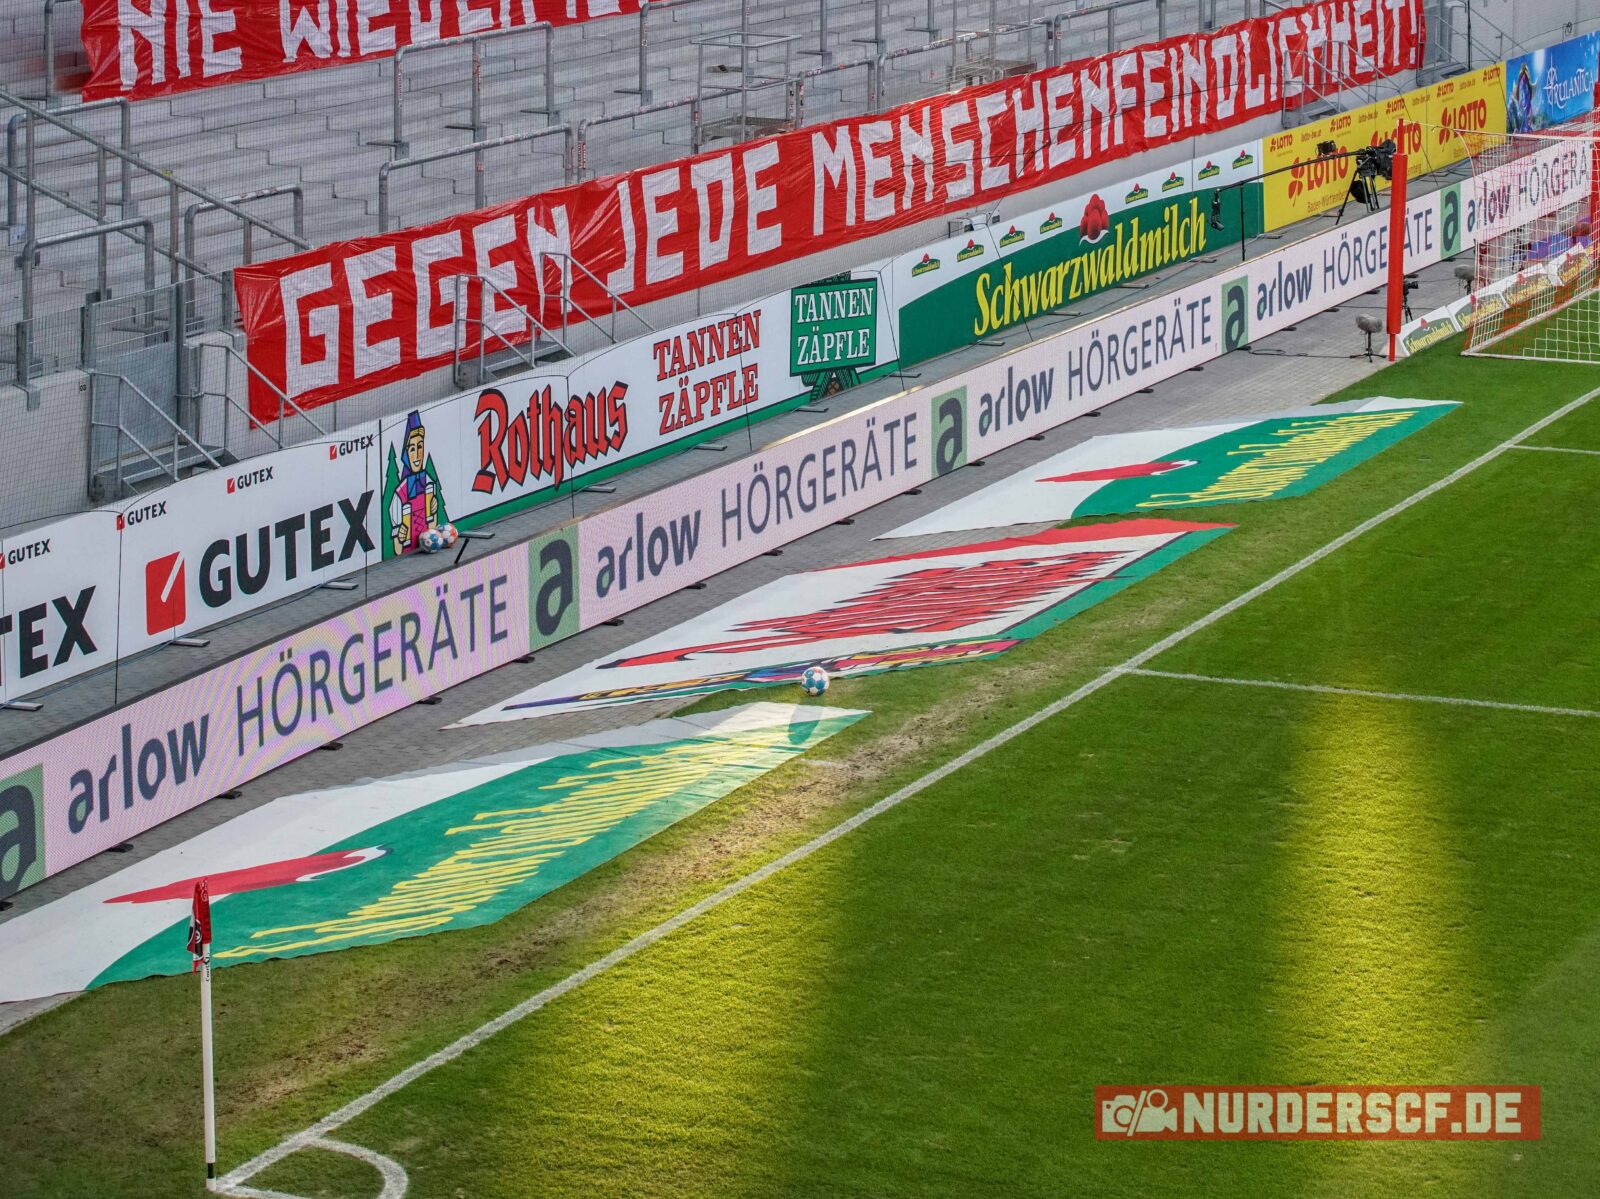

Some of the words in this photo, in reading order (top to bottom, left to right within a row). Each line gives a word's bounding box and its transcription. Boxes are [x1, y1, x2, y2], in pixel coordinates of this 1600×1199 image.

[1453, 98, 1487, 136] LOTTO
[1307, 145, 1349, 191] LOTTO
[1467, 181, 1511, 233] arlow
[279, 203, 575, 399] GEGEN
[605, 138, 783, 296] JEDE
[974, 197, 1207, 336] Schwarzwaldmilch
[1257, 262, 1313, 321] arlow
[1324, 208, 1433, 294] HÖRGEÄTE
[794, 287, 874, 325] TANNEN
[652, 308, 762, 382] TANNEN
[796, 326, 871, 366] ZÄPFLE
[978, 366, 1054, 437] arlow
[1068, 296, 1211, 401] HÖRGERÄTE
[658, 362, 759, 436] ZÄPFLE
[339, 434, 374, 457] GUTEX
[471, 380, 629, 494] Rothaus
[127, 501, 167, 526] GUTEX
[237, 466, 274, 490] GUTEX
[596, 510, 701, 600] arlow
[720, 412, 918, 548] HÖRGERÄTE
[8, 538, 51, 565] GUTEX
[199, 490, 376, 608] GUTEX
[67, 712, 210, 836] arlow
[236, 573, 510, 758] HÖRGERÄTE
